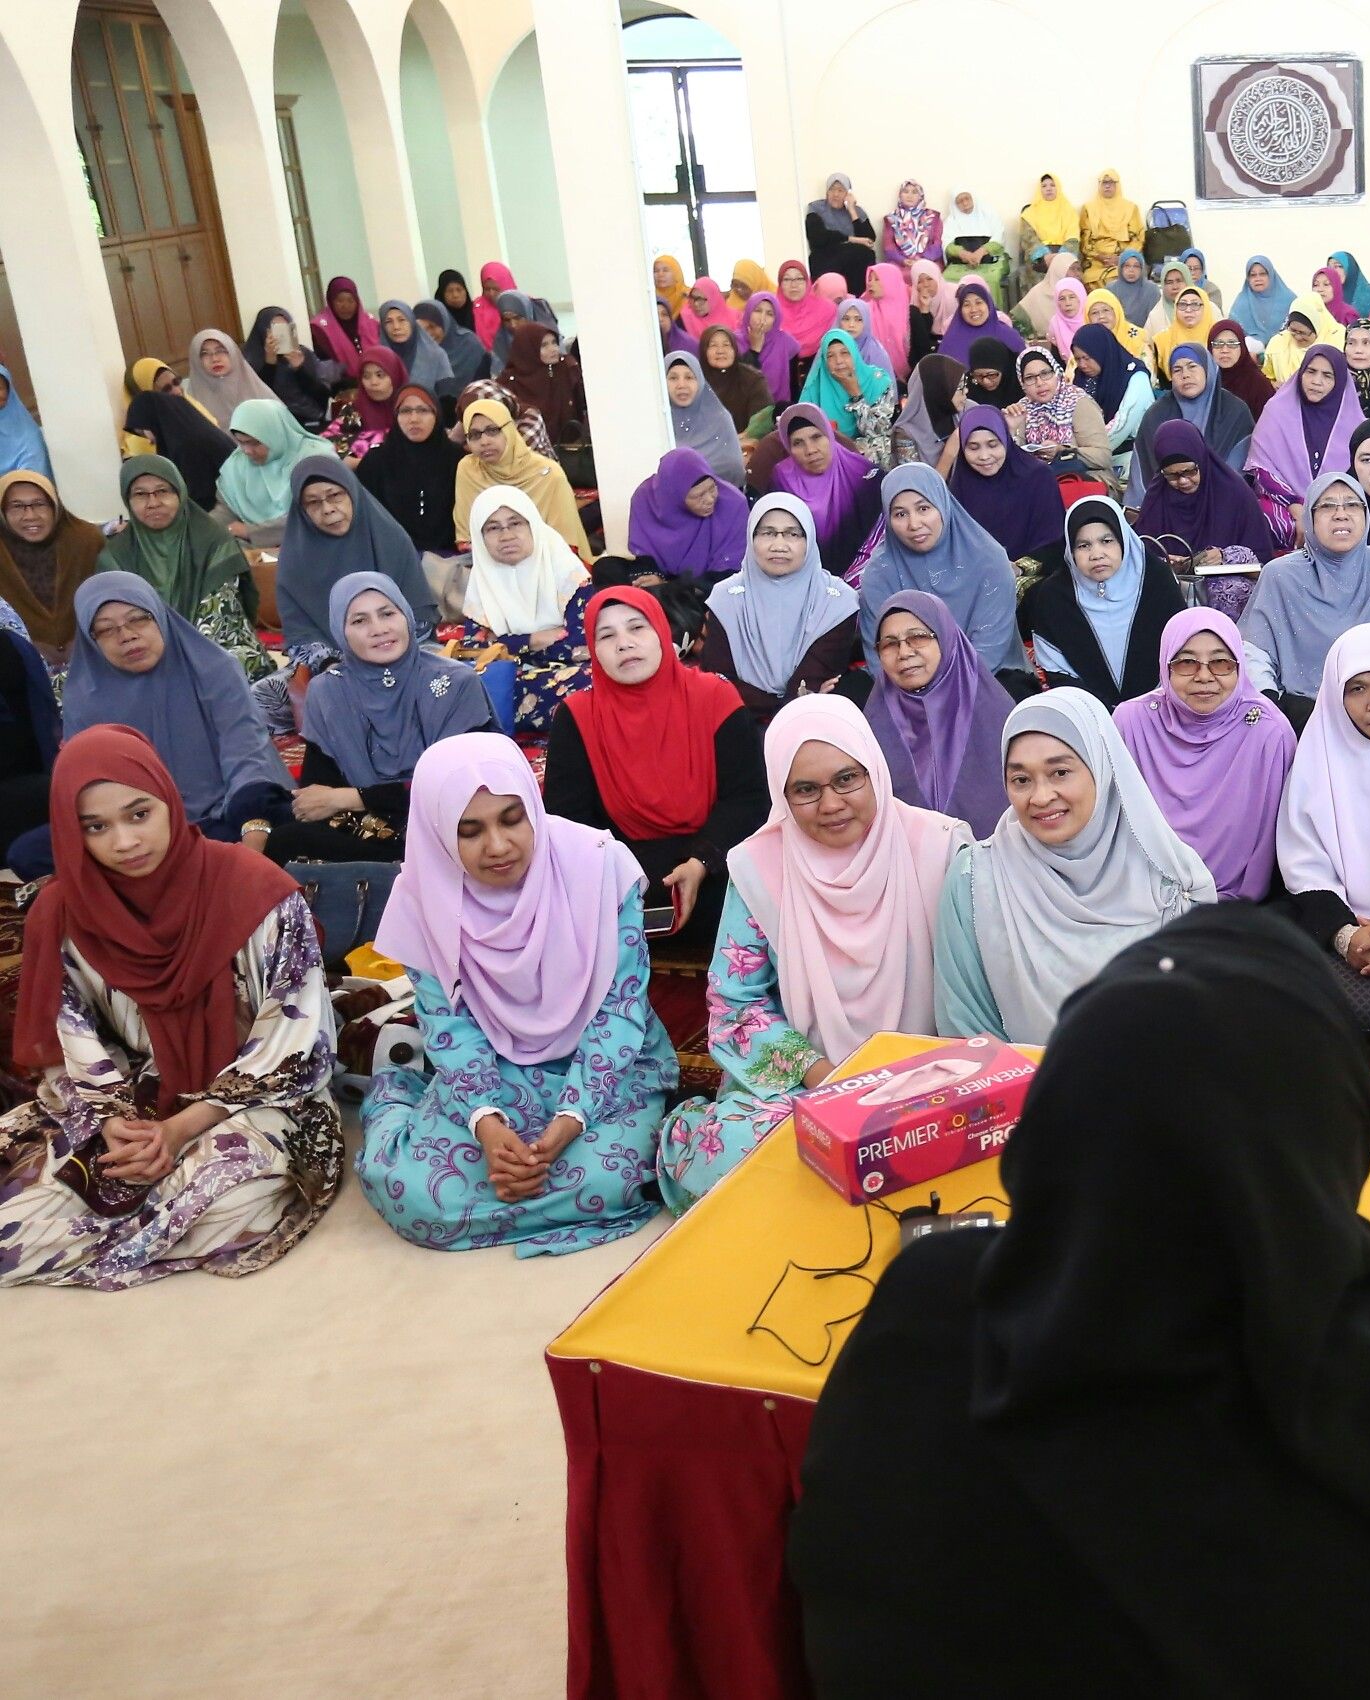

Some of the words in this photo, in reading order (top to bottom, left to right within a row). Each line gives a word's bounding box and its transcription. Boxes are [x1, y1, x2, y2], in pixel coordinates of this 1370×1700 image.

[833, 1069, 894, 1093] PRO!
[954, 1064, 1035, 1096] PREMIER
[858, 1122, 940, 1165] PREMIER
